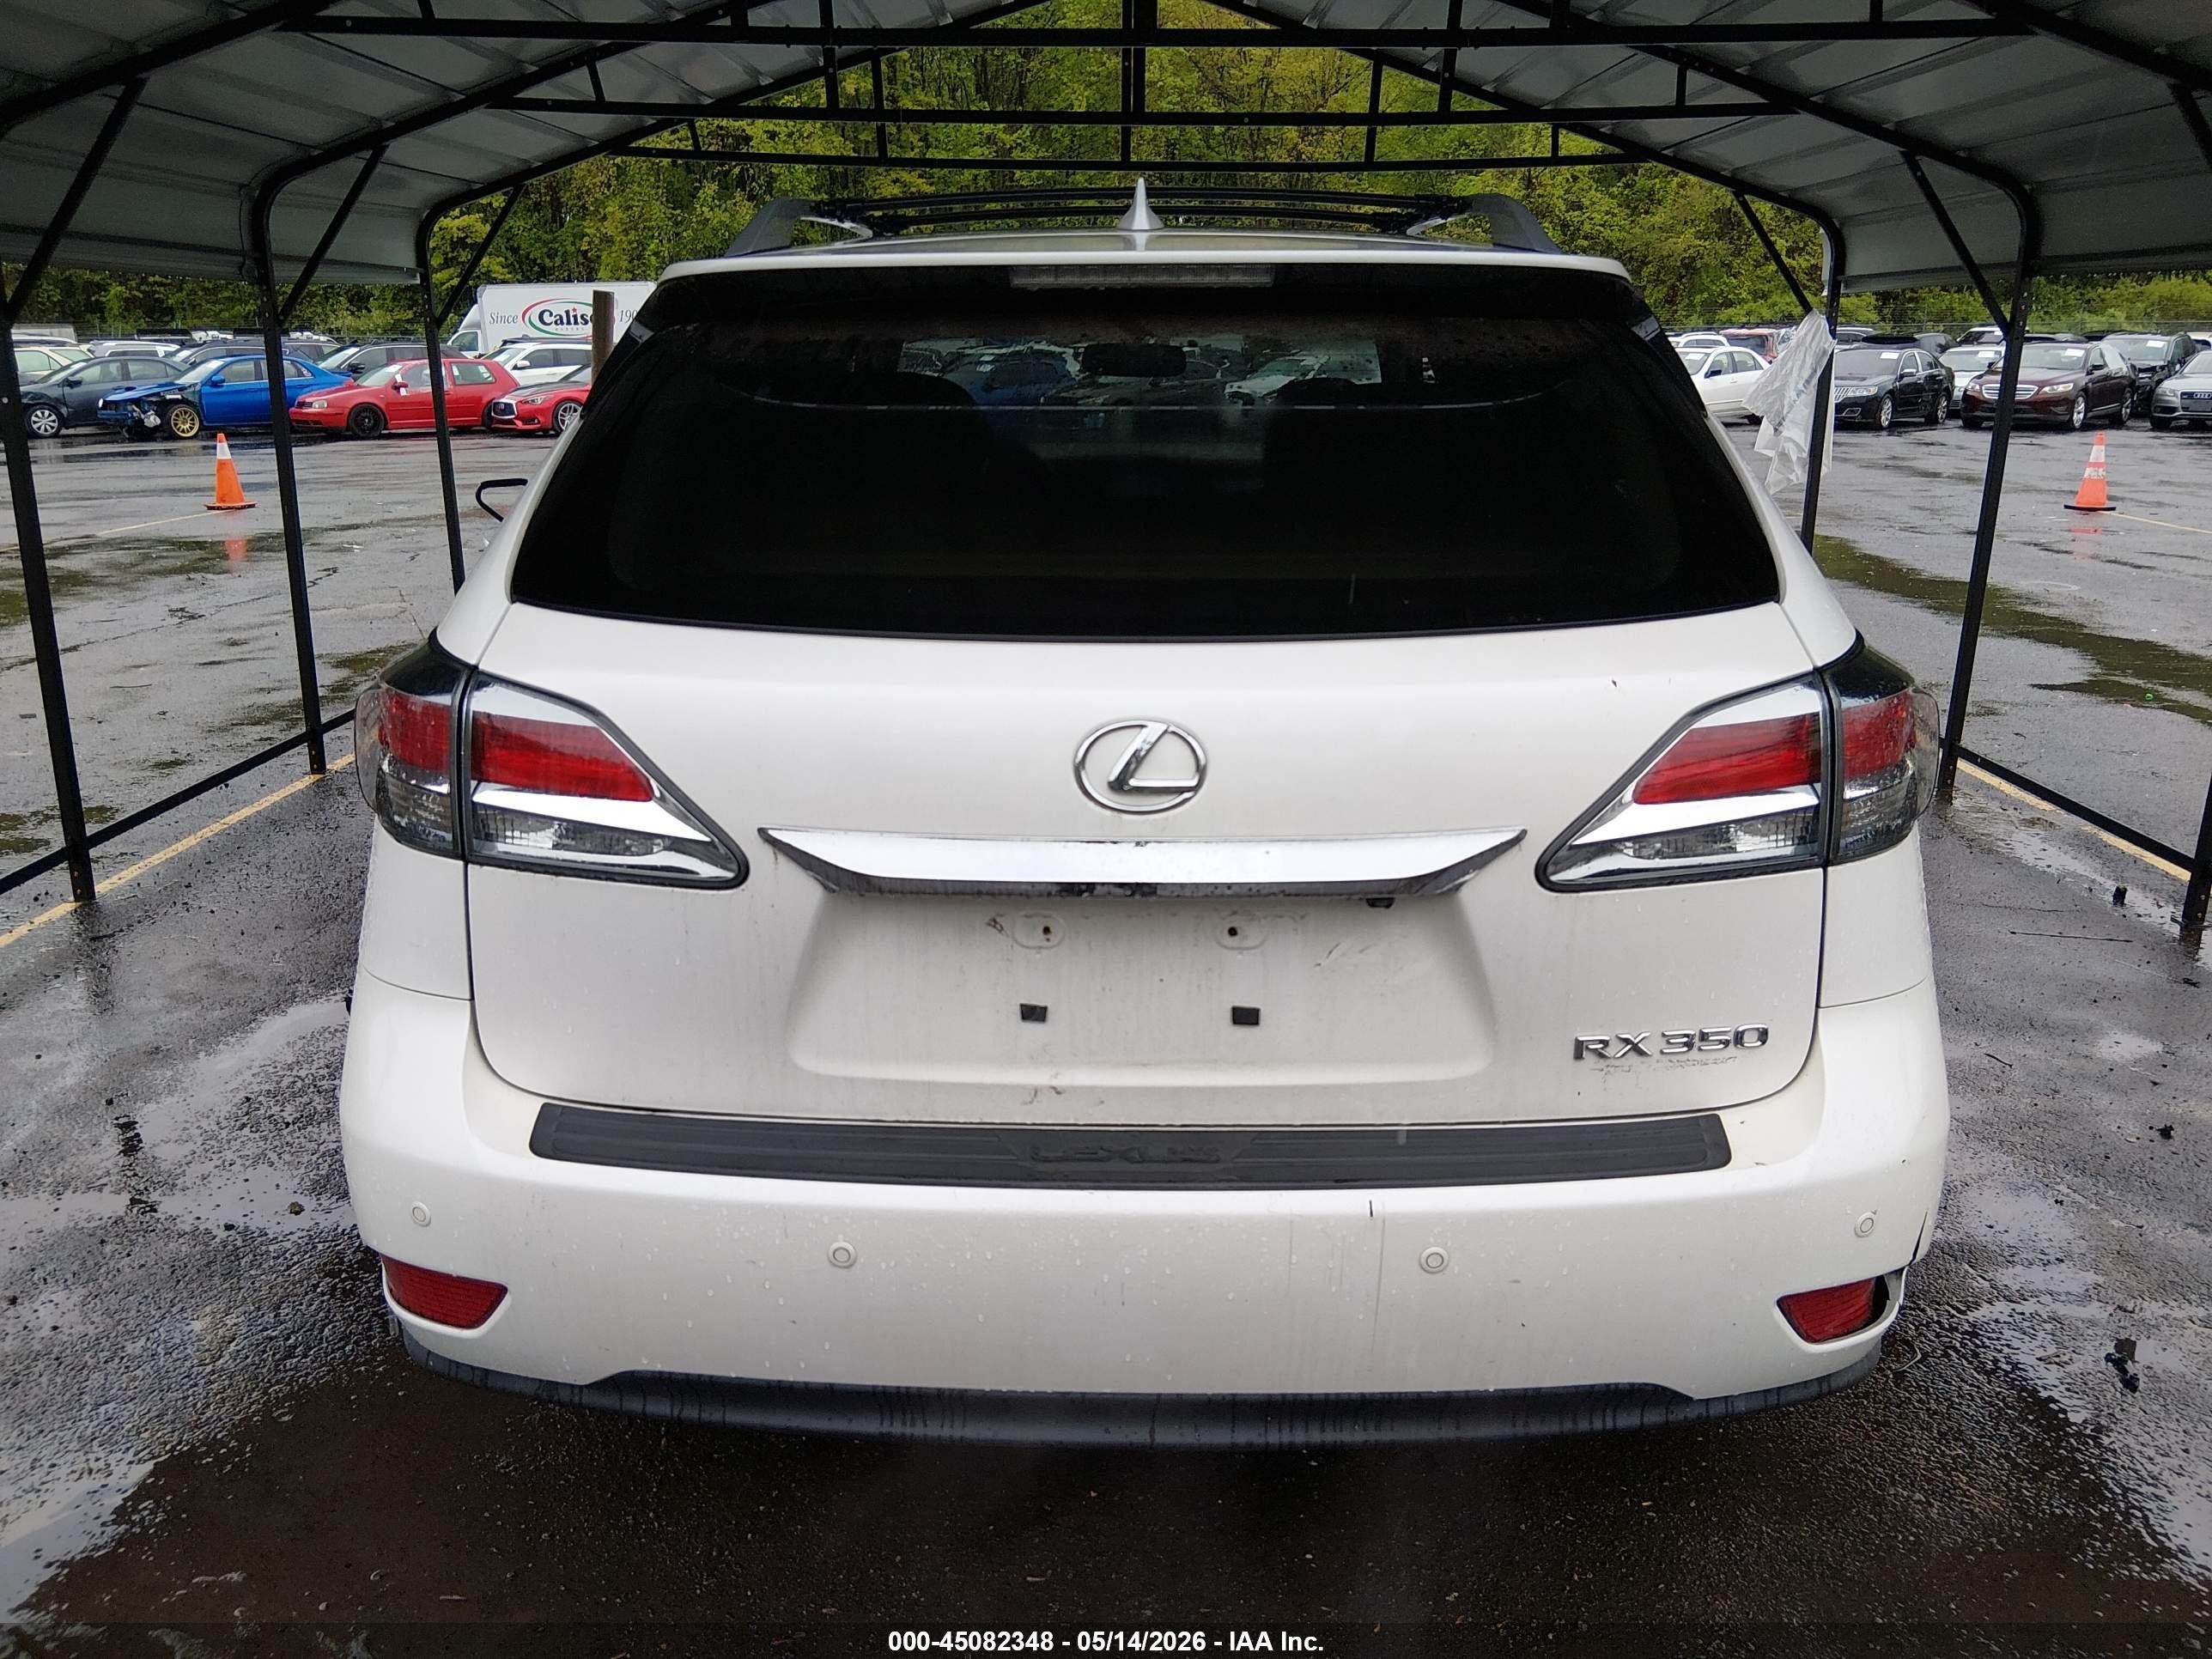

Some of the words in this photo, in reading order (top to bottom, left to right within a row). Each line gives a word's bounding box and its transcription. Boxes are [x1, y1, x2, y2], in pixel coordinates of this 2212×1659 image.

[489, 311, 519, 325] Since
[538, 307, 594, 326] Calis
[1572, 1031, 1653, 1060] RX
[1659, 1023, 1770, 1055] 350
